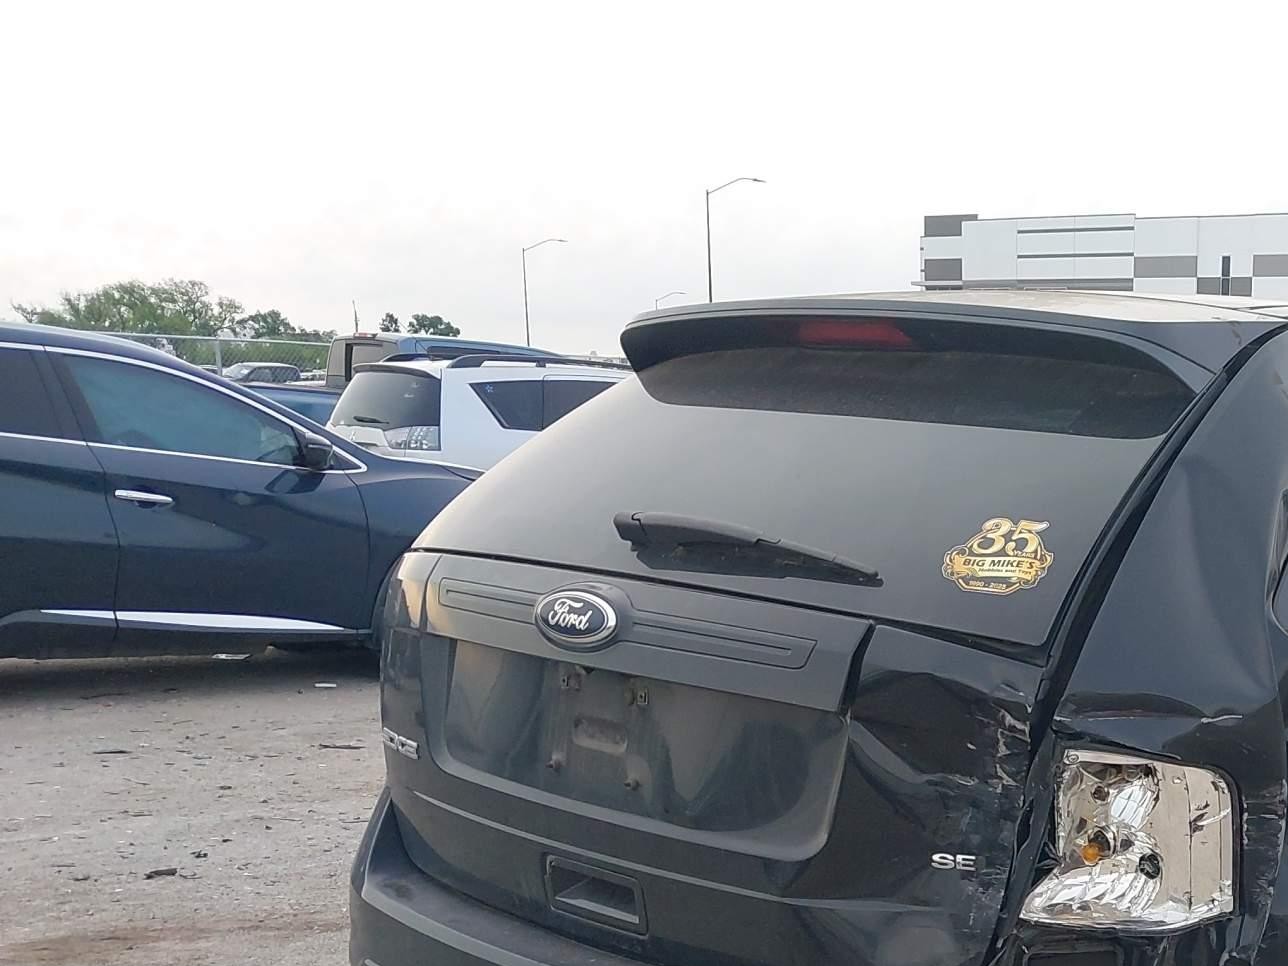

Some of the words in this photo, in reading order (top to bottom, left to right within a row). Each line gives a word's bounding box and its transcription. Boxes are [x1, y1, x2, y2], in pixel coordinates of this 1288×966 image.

[972, 517, 1048, 556] 35
[963, 558, 986, 567] BIG
[988, 559, 1036, 569] MIKE'S
[548, 598, 593, 630] Ford
[931, 853, 977, 872] SE
